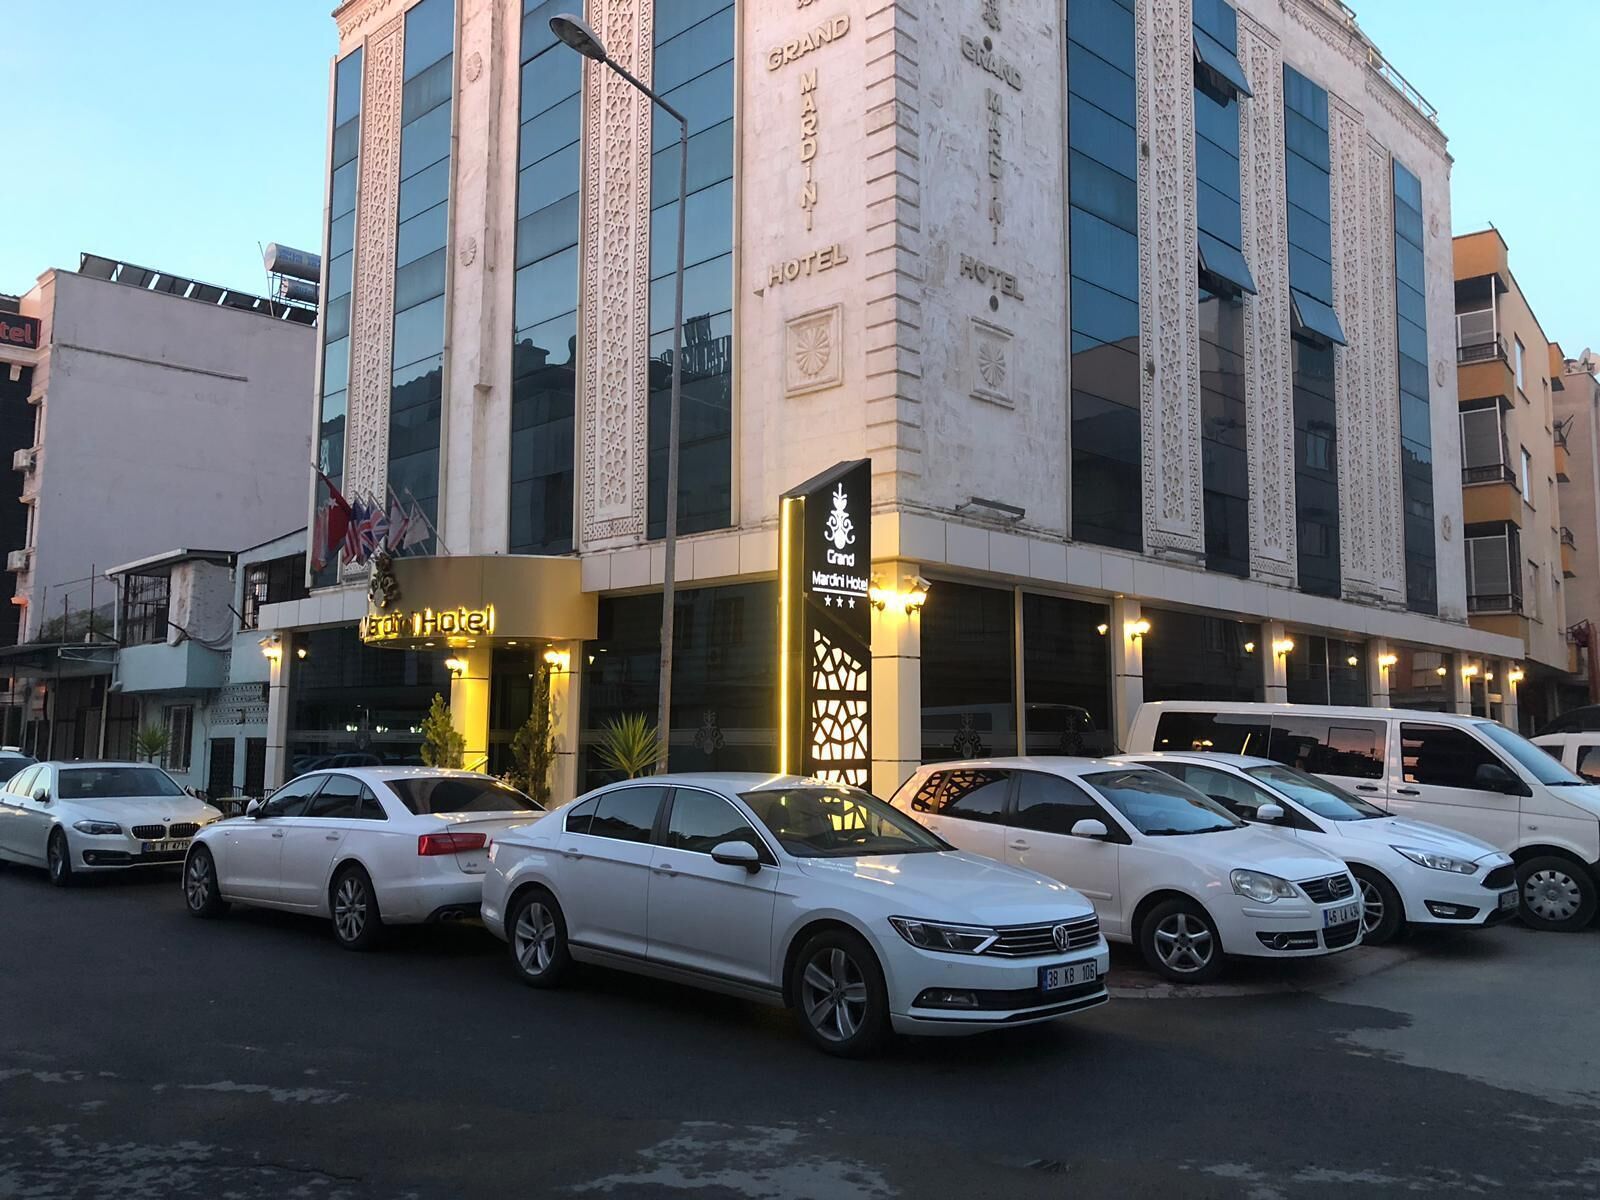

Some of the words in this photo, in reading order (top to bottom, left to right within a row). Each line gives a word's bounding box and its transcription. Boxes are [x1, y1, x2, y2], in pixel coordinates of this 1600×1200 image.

[767, 15, 850, 72] GRAND
[768, 243, 849, 288] HOTEL
[960, 252, 1025, 302] HOTEL
[827, 549, 855, 567] Grand
[812, 570, 845, 588] Mardini
[846, 574, 868, 591] Hotel
[421, 604, 495, 637] Hotel
[1048, 970, 1058, 988] 38
[1064, 967, 1075, 984] KB
